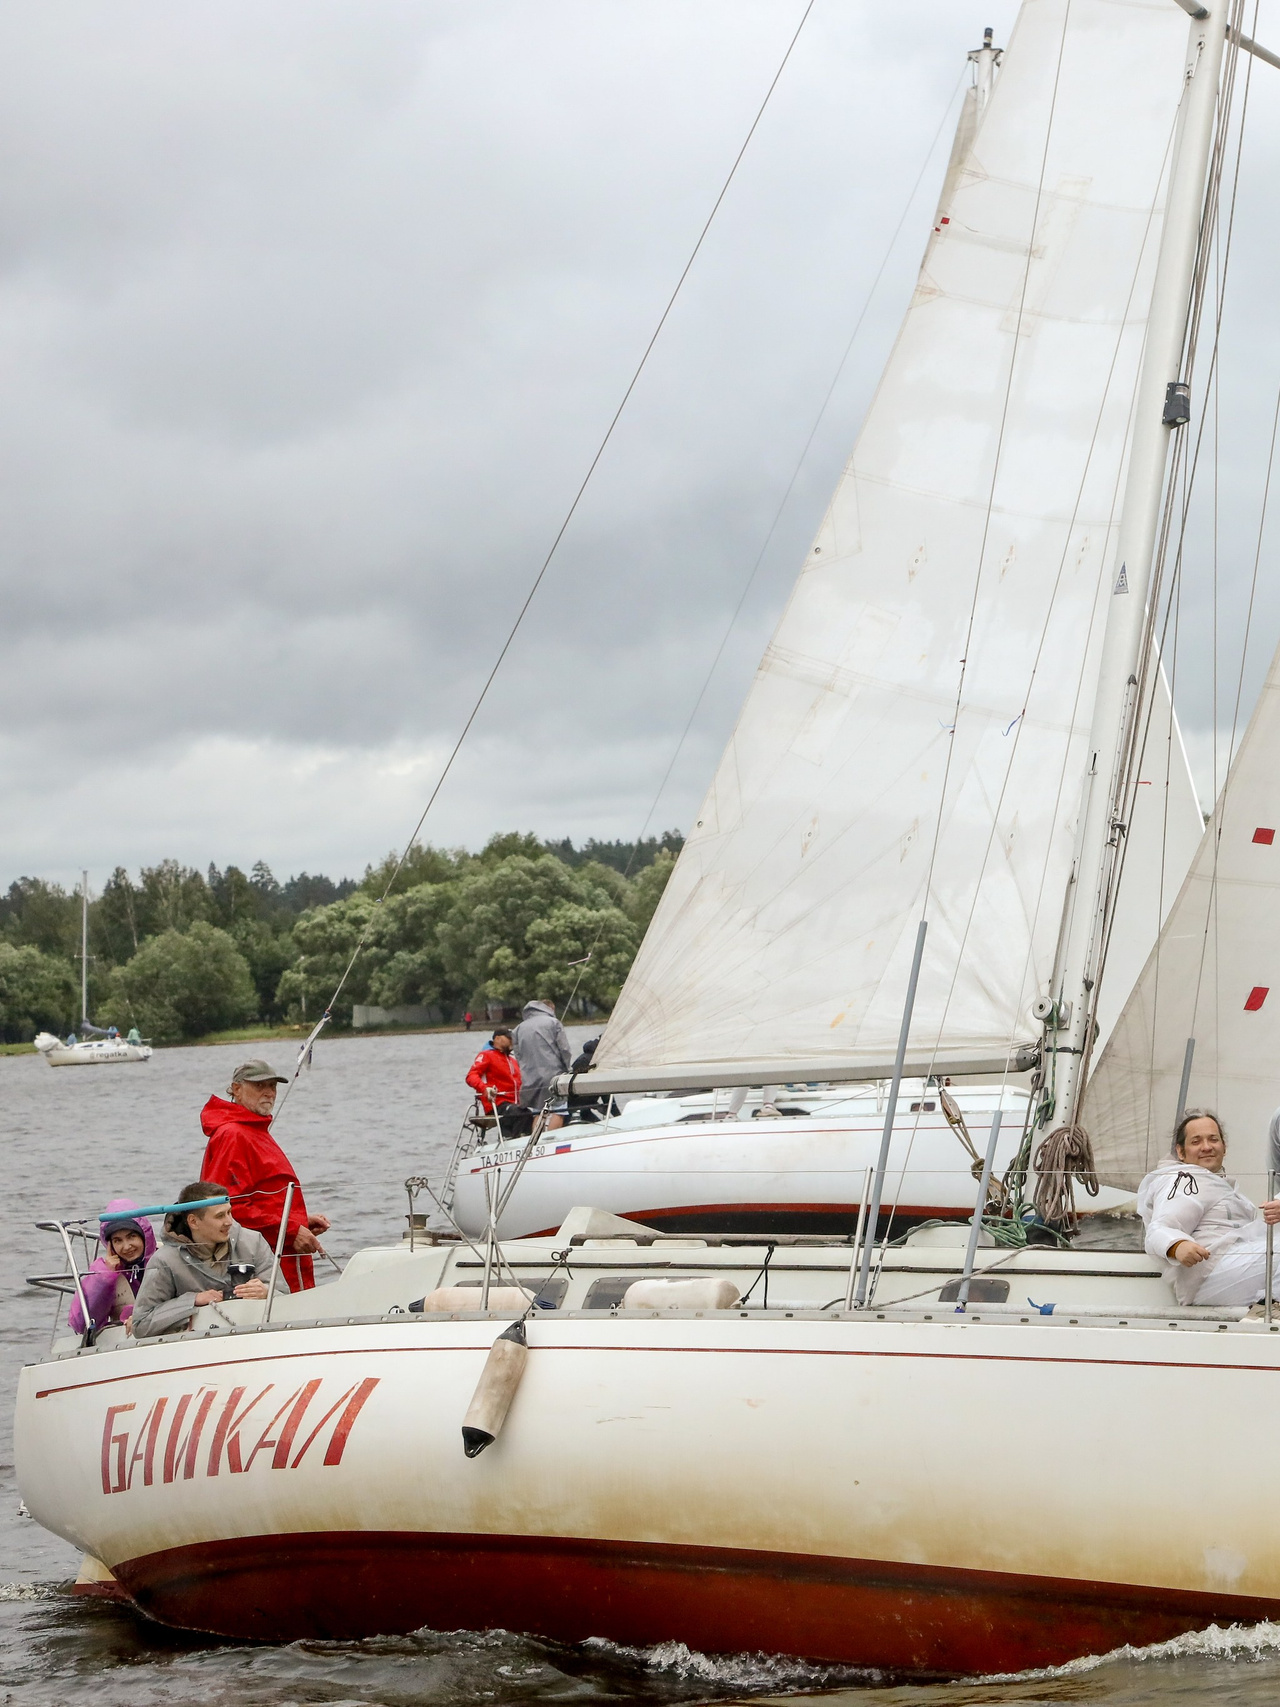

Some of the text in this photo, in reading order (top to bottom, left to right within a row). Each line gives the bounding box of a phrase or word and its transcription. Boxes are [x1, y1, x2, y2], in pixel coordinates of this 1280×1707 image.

[481, 1155, 492, 1168] TA
[493, 1152, 513, 1166] 2071
[535, 1145, 545, 1157] 50
[101, 1377, 381, 1494] БАЙКАЛ
